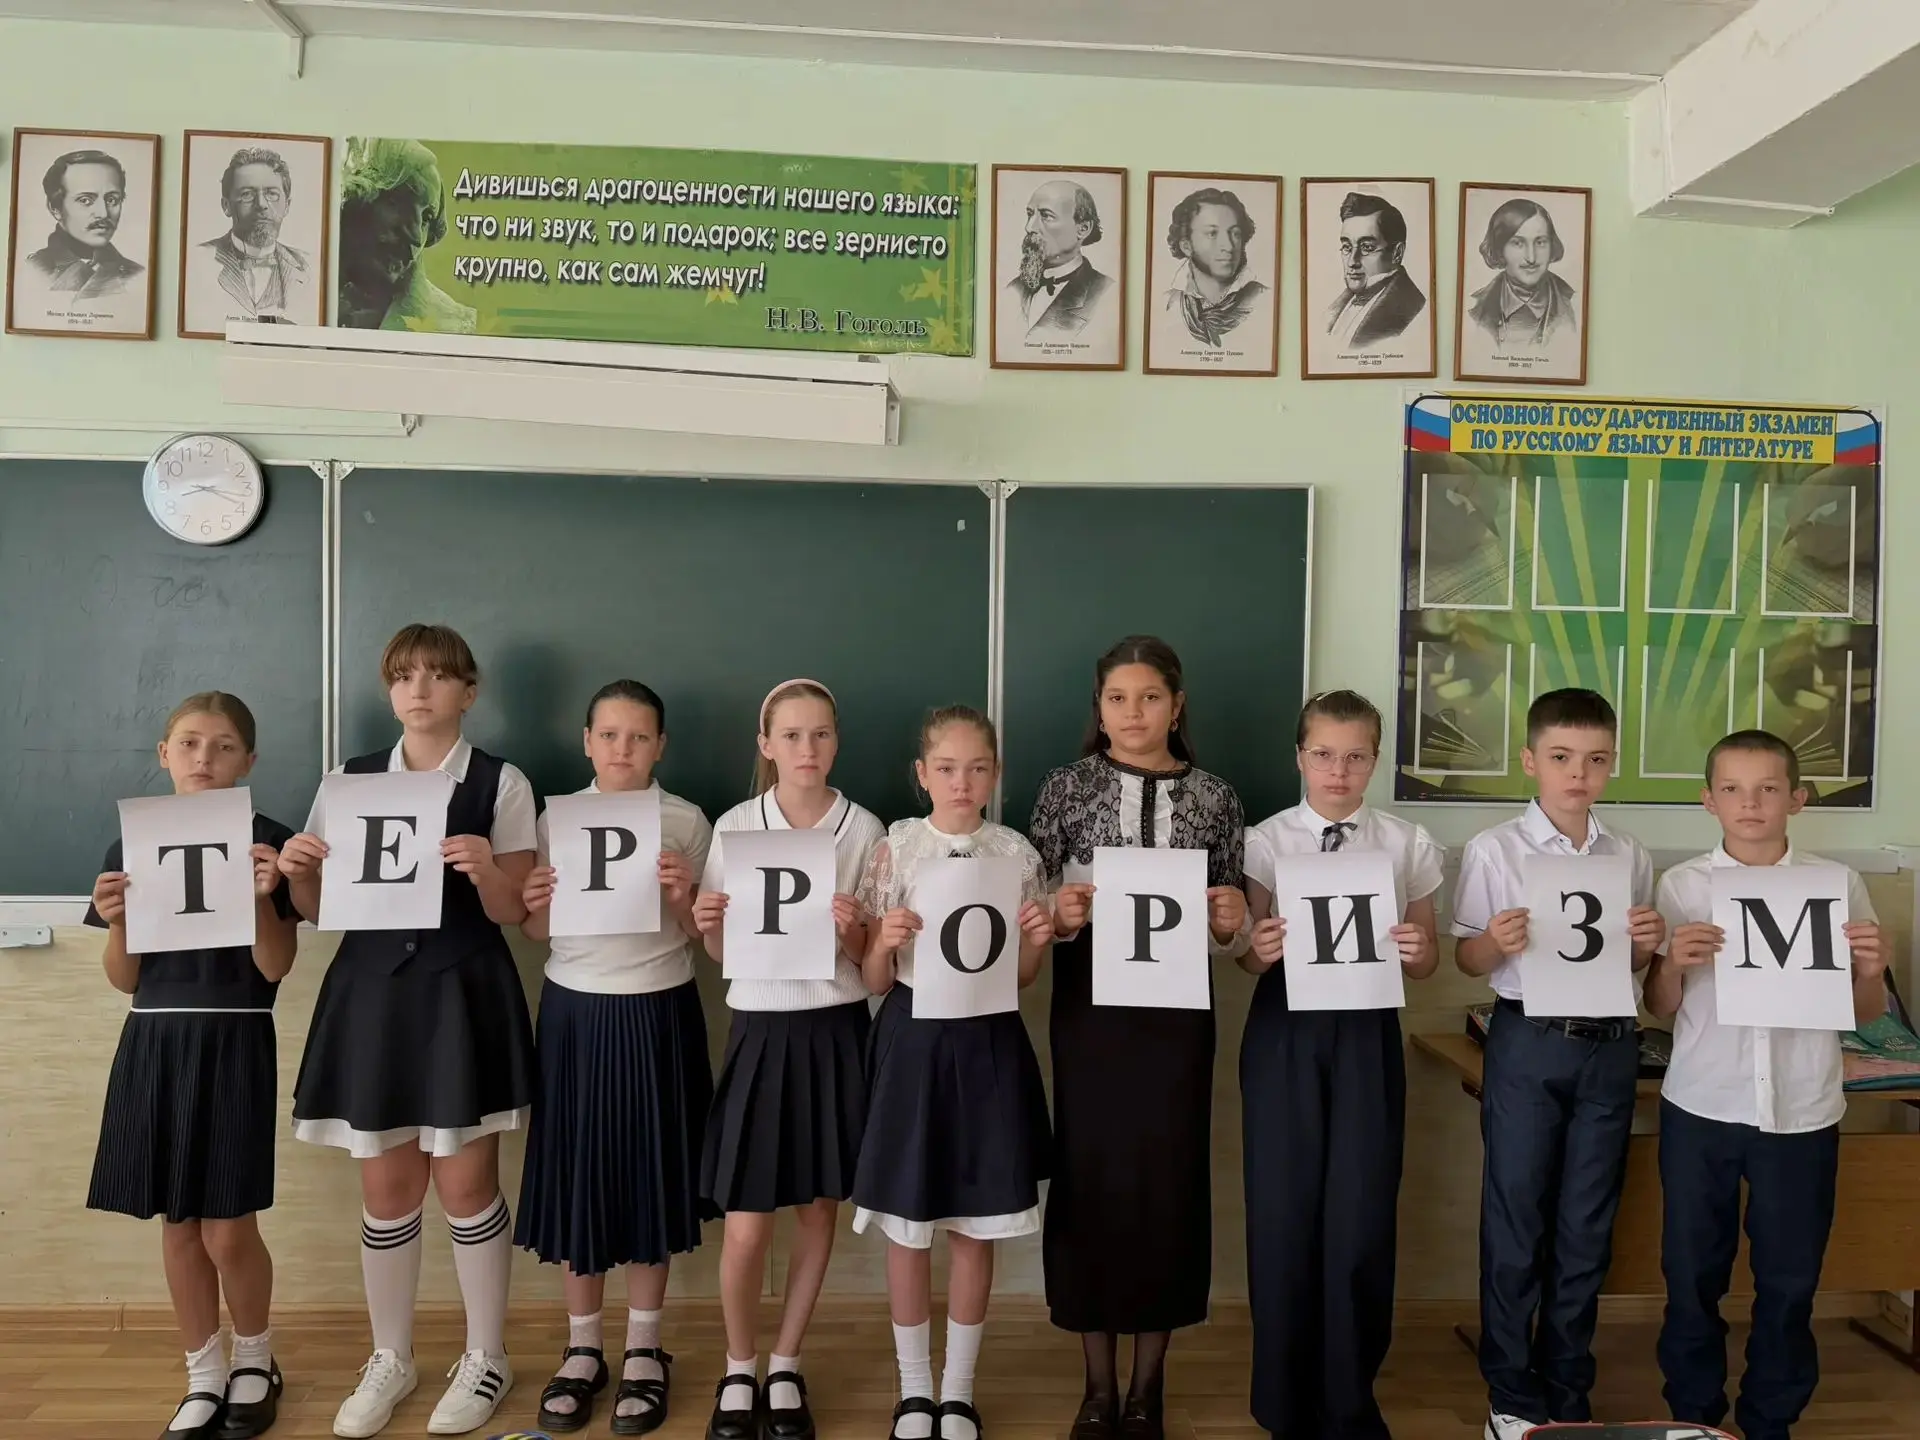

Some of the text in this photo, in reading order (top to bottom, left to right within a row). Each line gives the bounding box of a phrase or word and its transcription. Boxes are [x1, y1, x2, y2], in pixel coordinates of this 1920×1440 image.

[453, 167, 960, 216] Дивишься драгоценности нашего языка:
[455, 214, 948, 259] что ни звук, то и подарок; все зернисто
[453, 255, 766, 294] крупно, как сам жемчуг!
[765, 306, 927, 336] Н.В. Гоголь
[1451, 402, 1834, 436] ОСНОВНОЙ ГОСУДАРСТВЕННЫЙ ЭКЗАМЕН
[180, 448, 192, 462] 11
[196, 441, 214, 458] 12
[1471, 428, 1814, 460] ПО РУССКОМУ ЯЗЫКУ И ЛИТЕРАТУРЕ
[165, 460, 183, 477] 10
[235, 461, 246, 478] 2
[200, 520, 212, 536] 6
[221, 515, 232, 531] 5
[234, 502, 246, 517] 4
[352, 816, 419, 884] Е
[581, 827, 637, 892] Р
[158, 843, 229, 915] Т
[754, 867, 811, 935] Р
[940, 904, 1007, 974] О
[1126, 893, 1183, 963] Р
[1301, 893, 1387, 965] И
[1557, 891, 1604, 963] З
[1730, 898, 1846, 971] М
